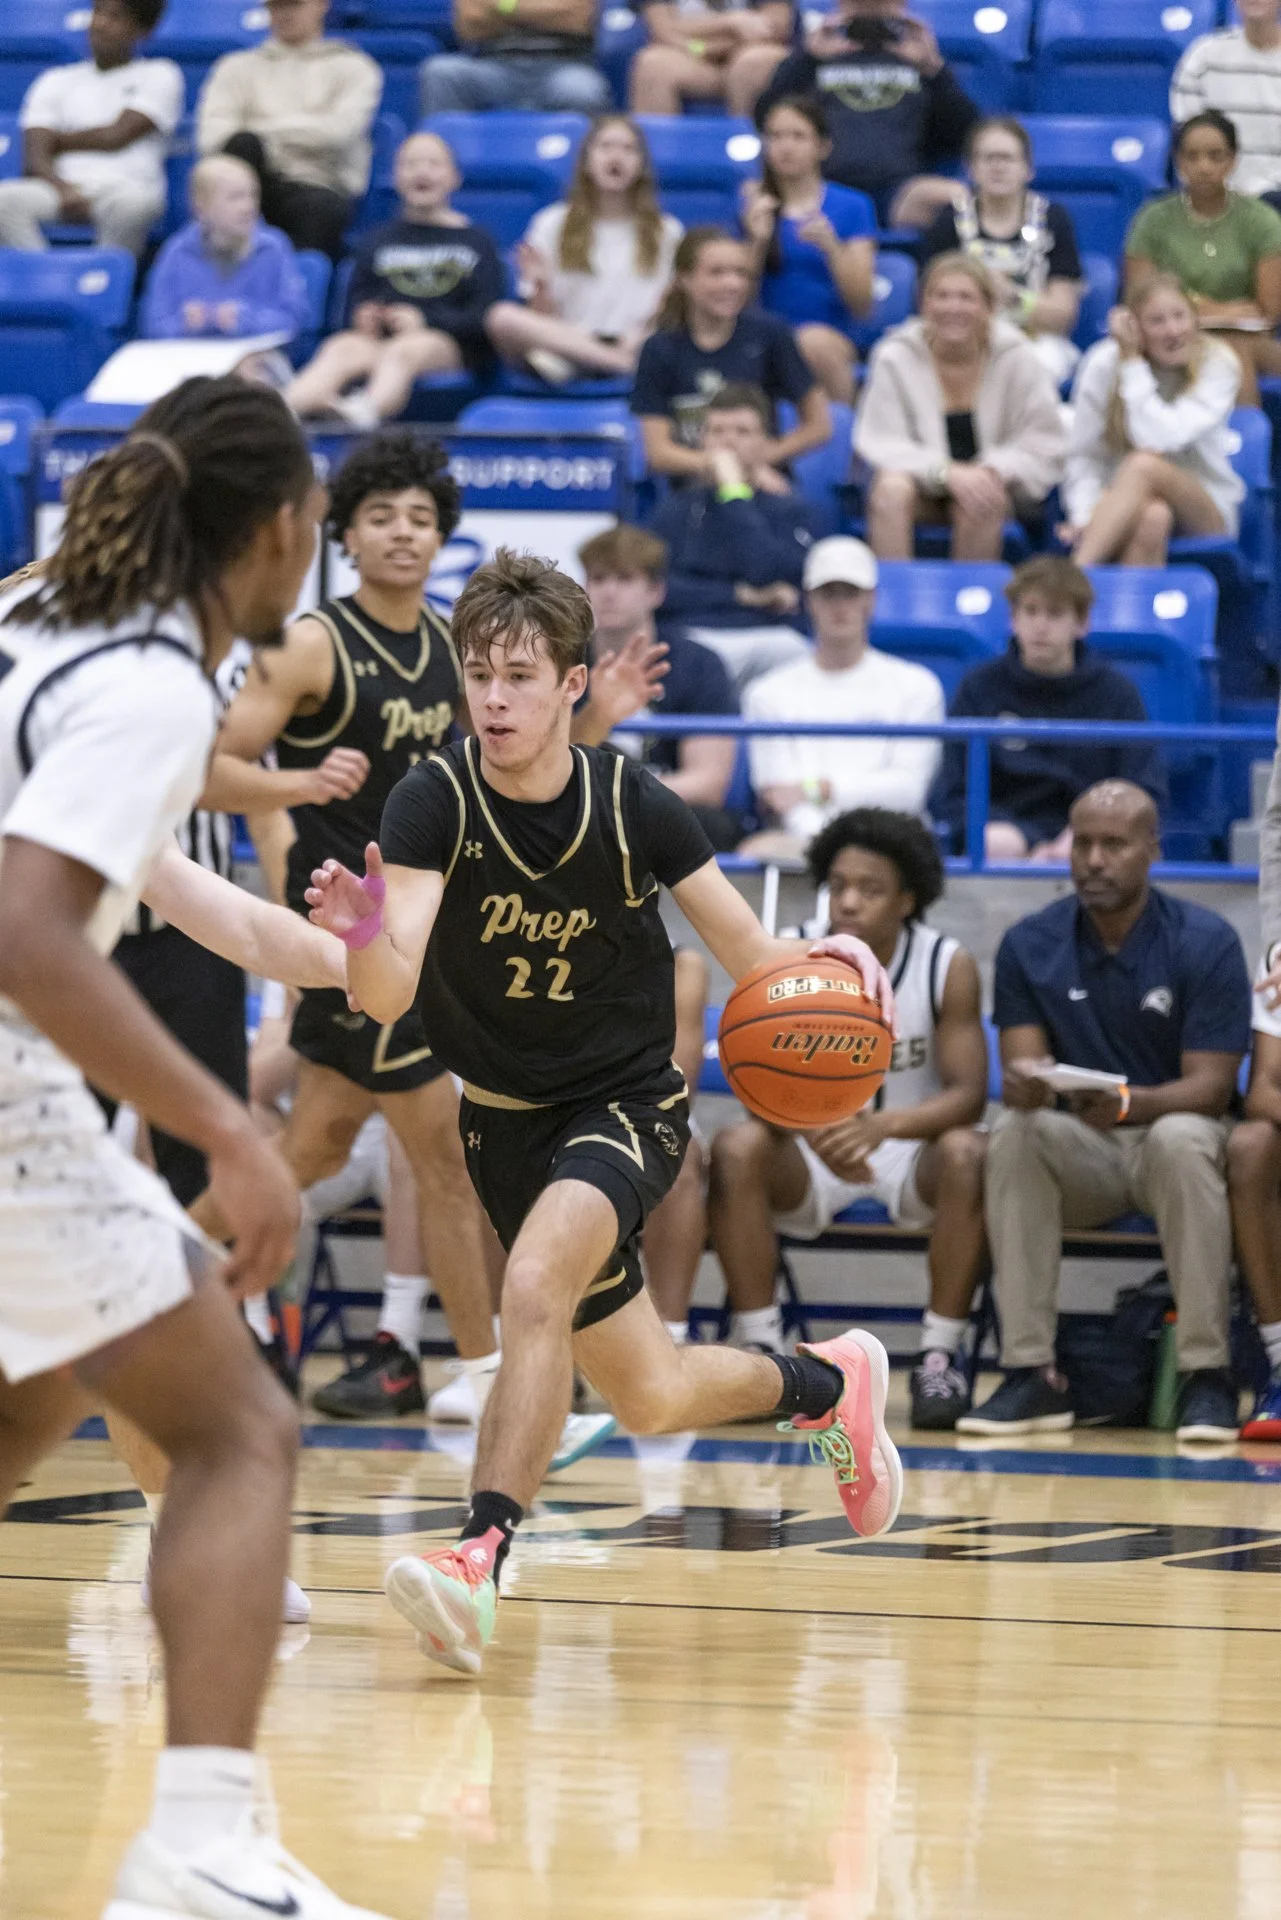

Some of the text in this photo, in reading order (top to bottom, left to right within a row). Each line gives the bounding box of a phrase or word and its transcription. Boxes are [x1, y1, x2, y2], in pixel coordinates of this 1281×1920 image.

[448, 455, 616, 491] SUPPORT
[380, 697, 452, 751] Prep
[480, 893, 597, 952] Prep
[505, 956, 574, 1001] 22
[768, 976, 818, 1004] PRO
[771, 1032, 878, 1065] Baden
